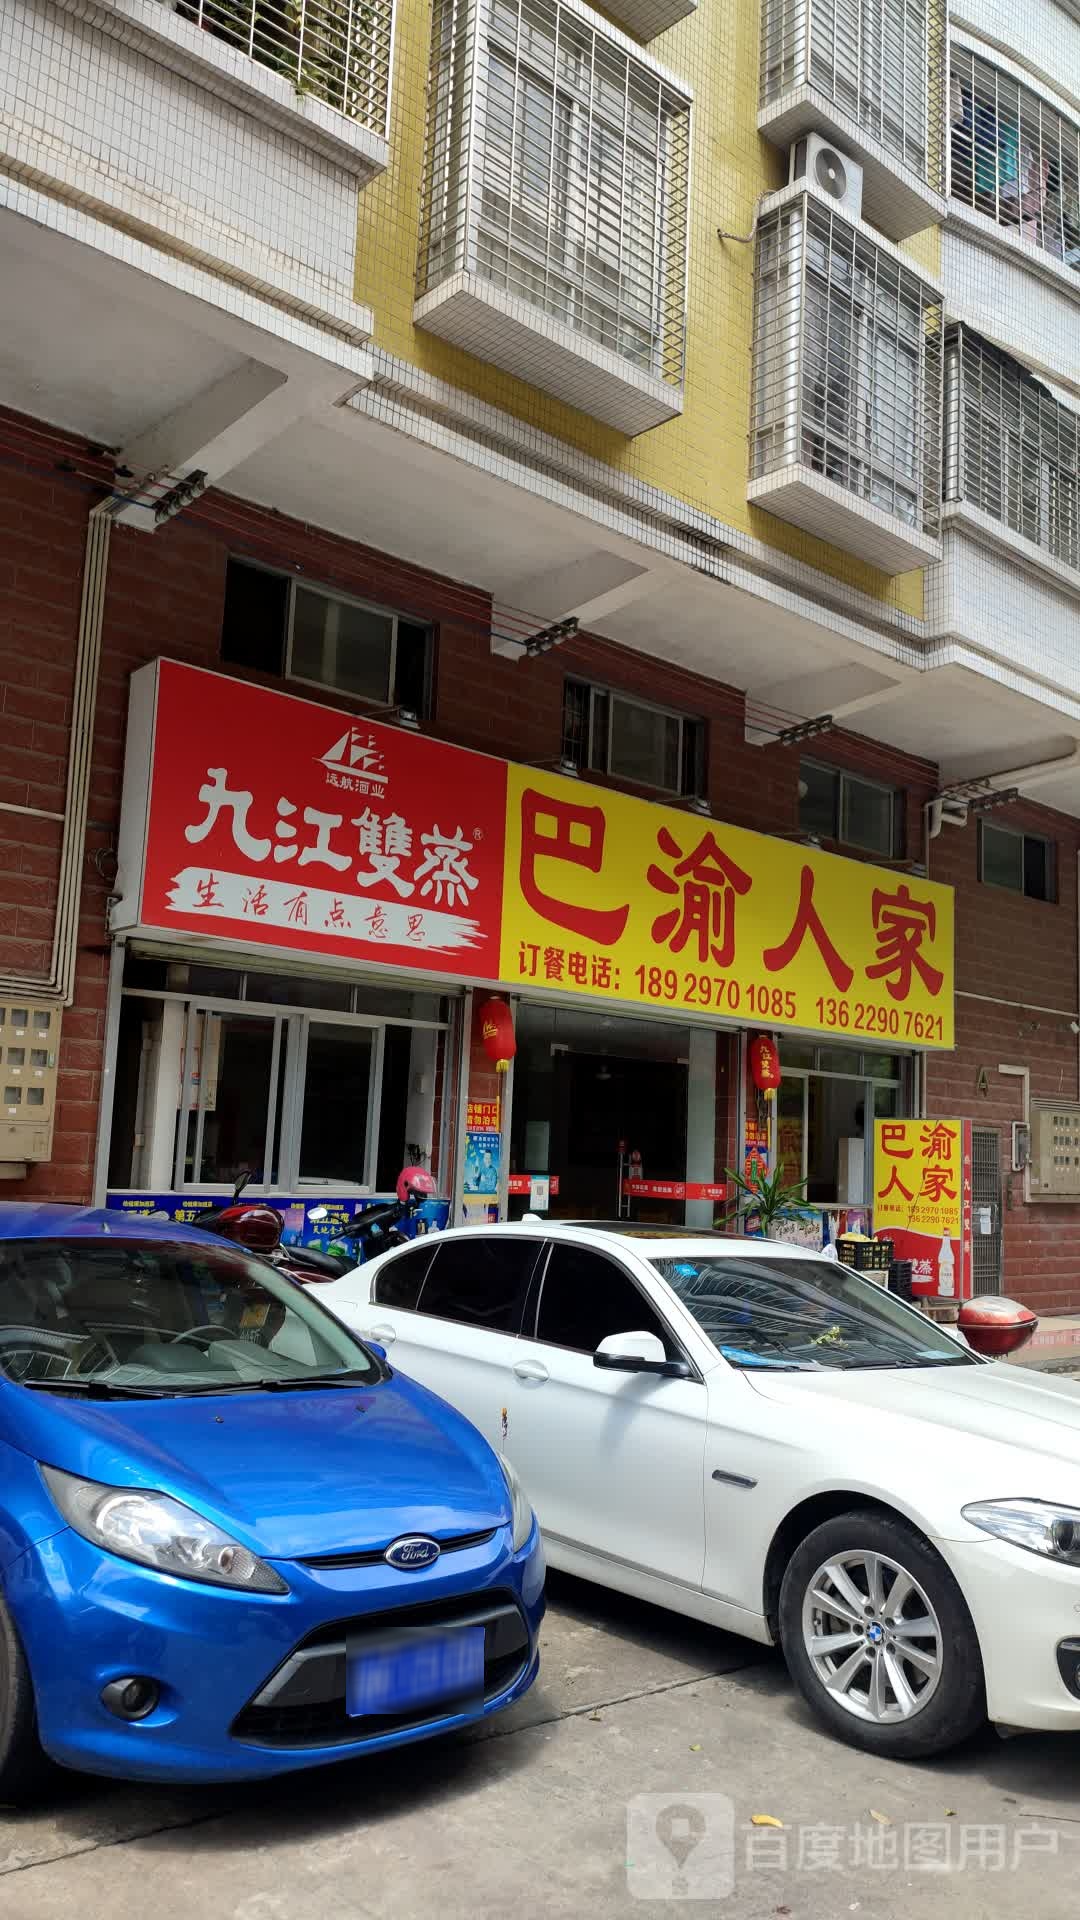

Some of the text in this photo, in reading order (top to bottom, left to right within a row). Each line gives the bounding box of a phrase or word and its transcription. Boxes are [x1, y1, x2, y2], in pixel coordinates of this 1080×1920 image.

[325, 772, 386, 799] 远航酒业
[191, 872, 430, 943] 生活有点意思
[519, 787, 945, 1001] 巴渝人家
[880, 1123, 957, 1161] 巴渝
[877, 1165, 958, 1203] 人家
[401, 1544, 429, 1560] Ford
